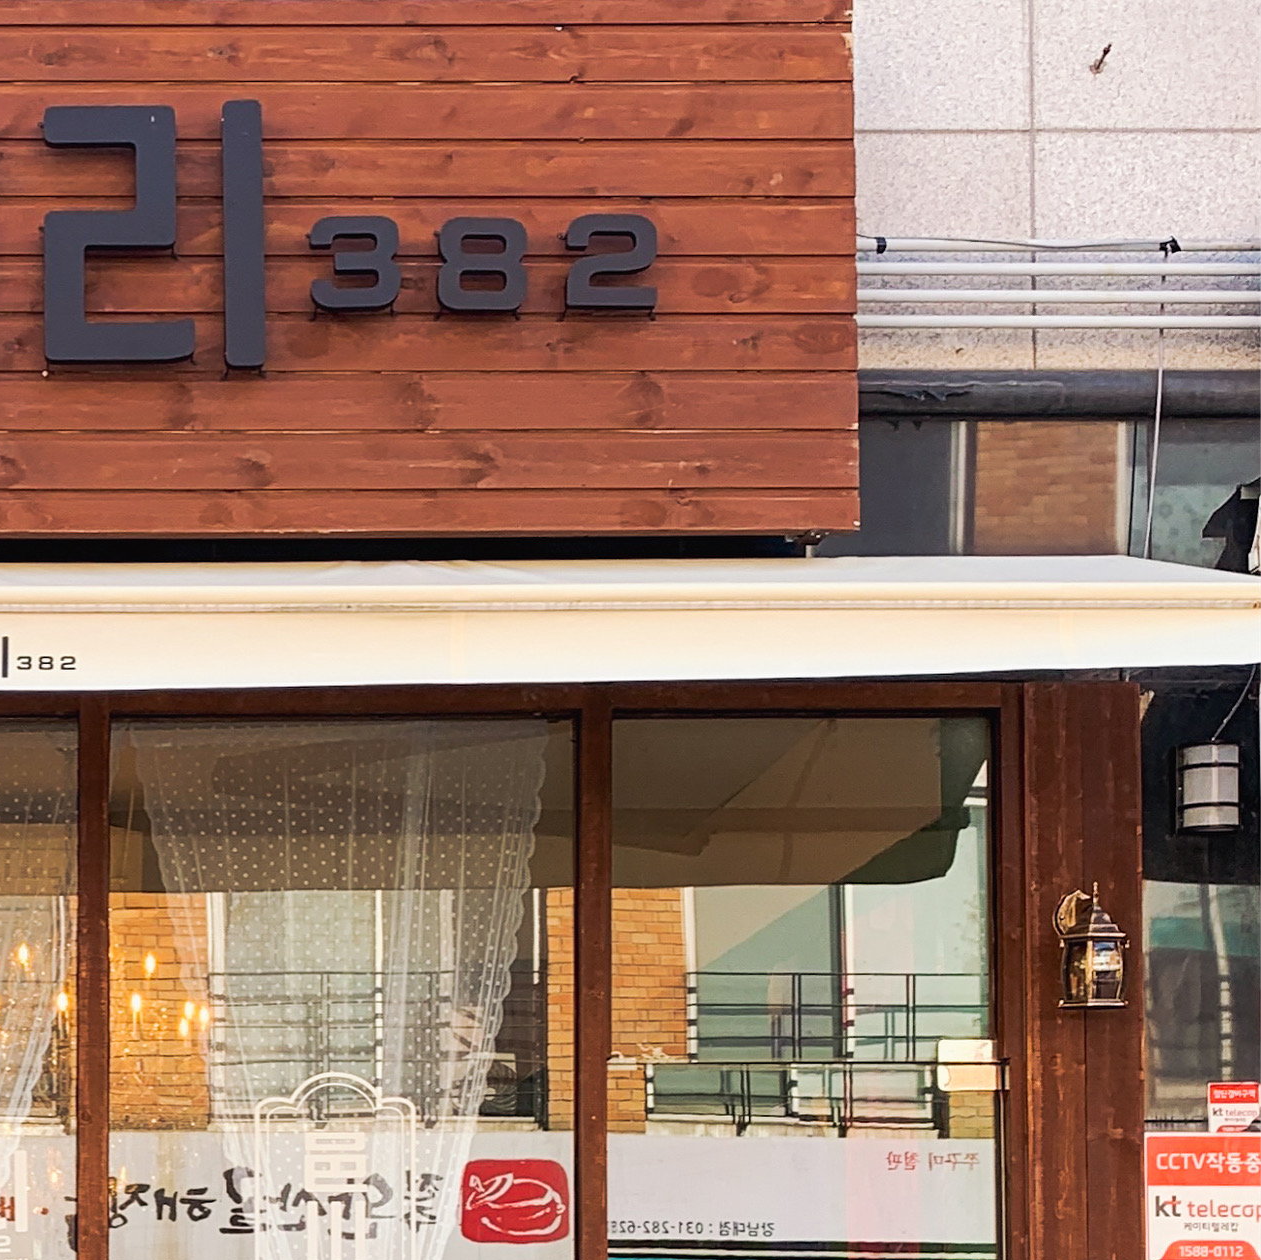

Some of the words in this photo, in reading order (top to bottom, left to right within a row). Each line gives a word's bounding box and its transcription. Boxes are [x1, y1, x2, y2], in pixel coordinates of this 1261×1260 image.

[308, 214, 659, 312] 382
[16, 655, 77, 671] 382
[1154, 1195, 1182, 1218] kt
[1178, 1244, 1244, 1258] 1588-0112
